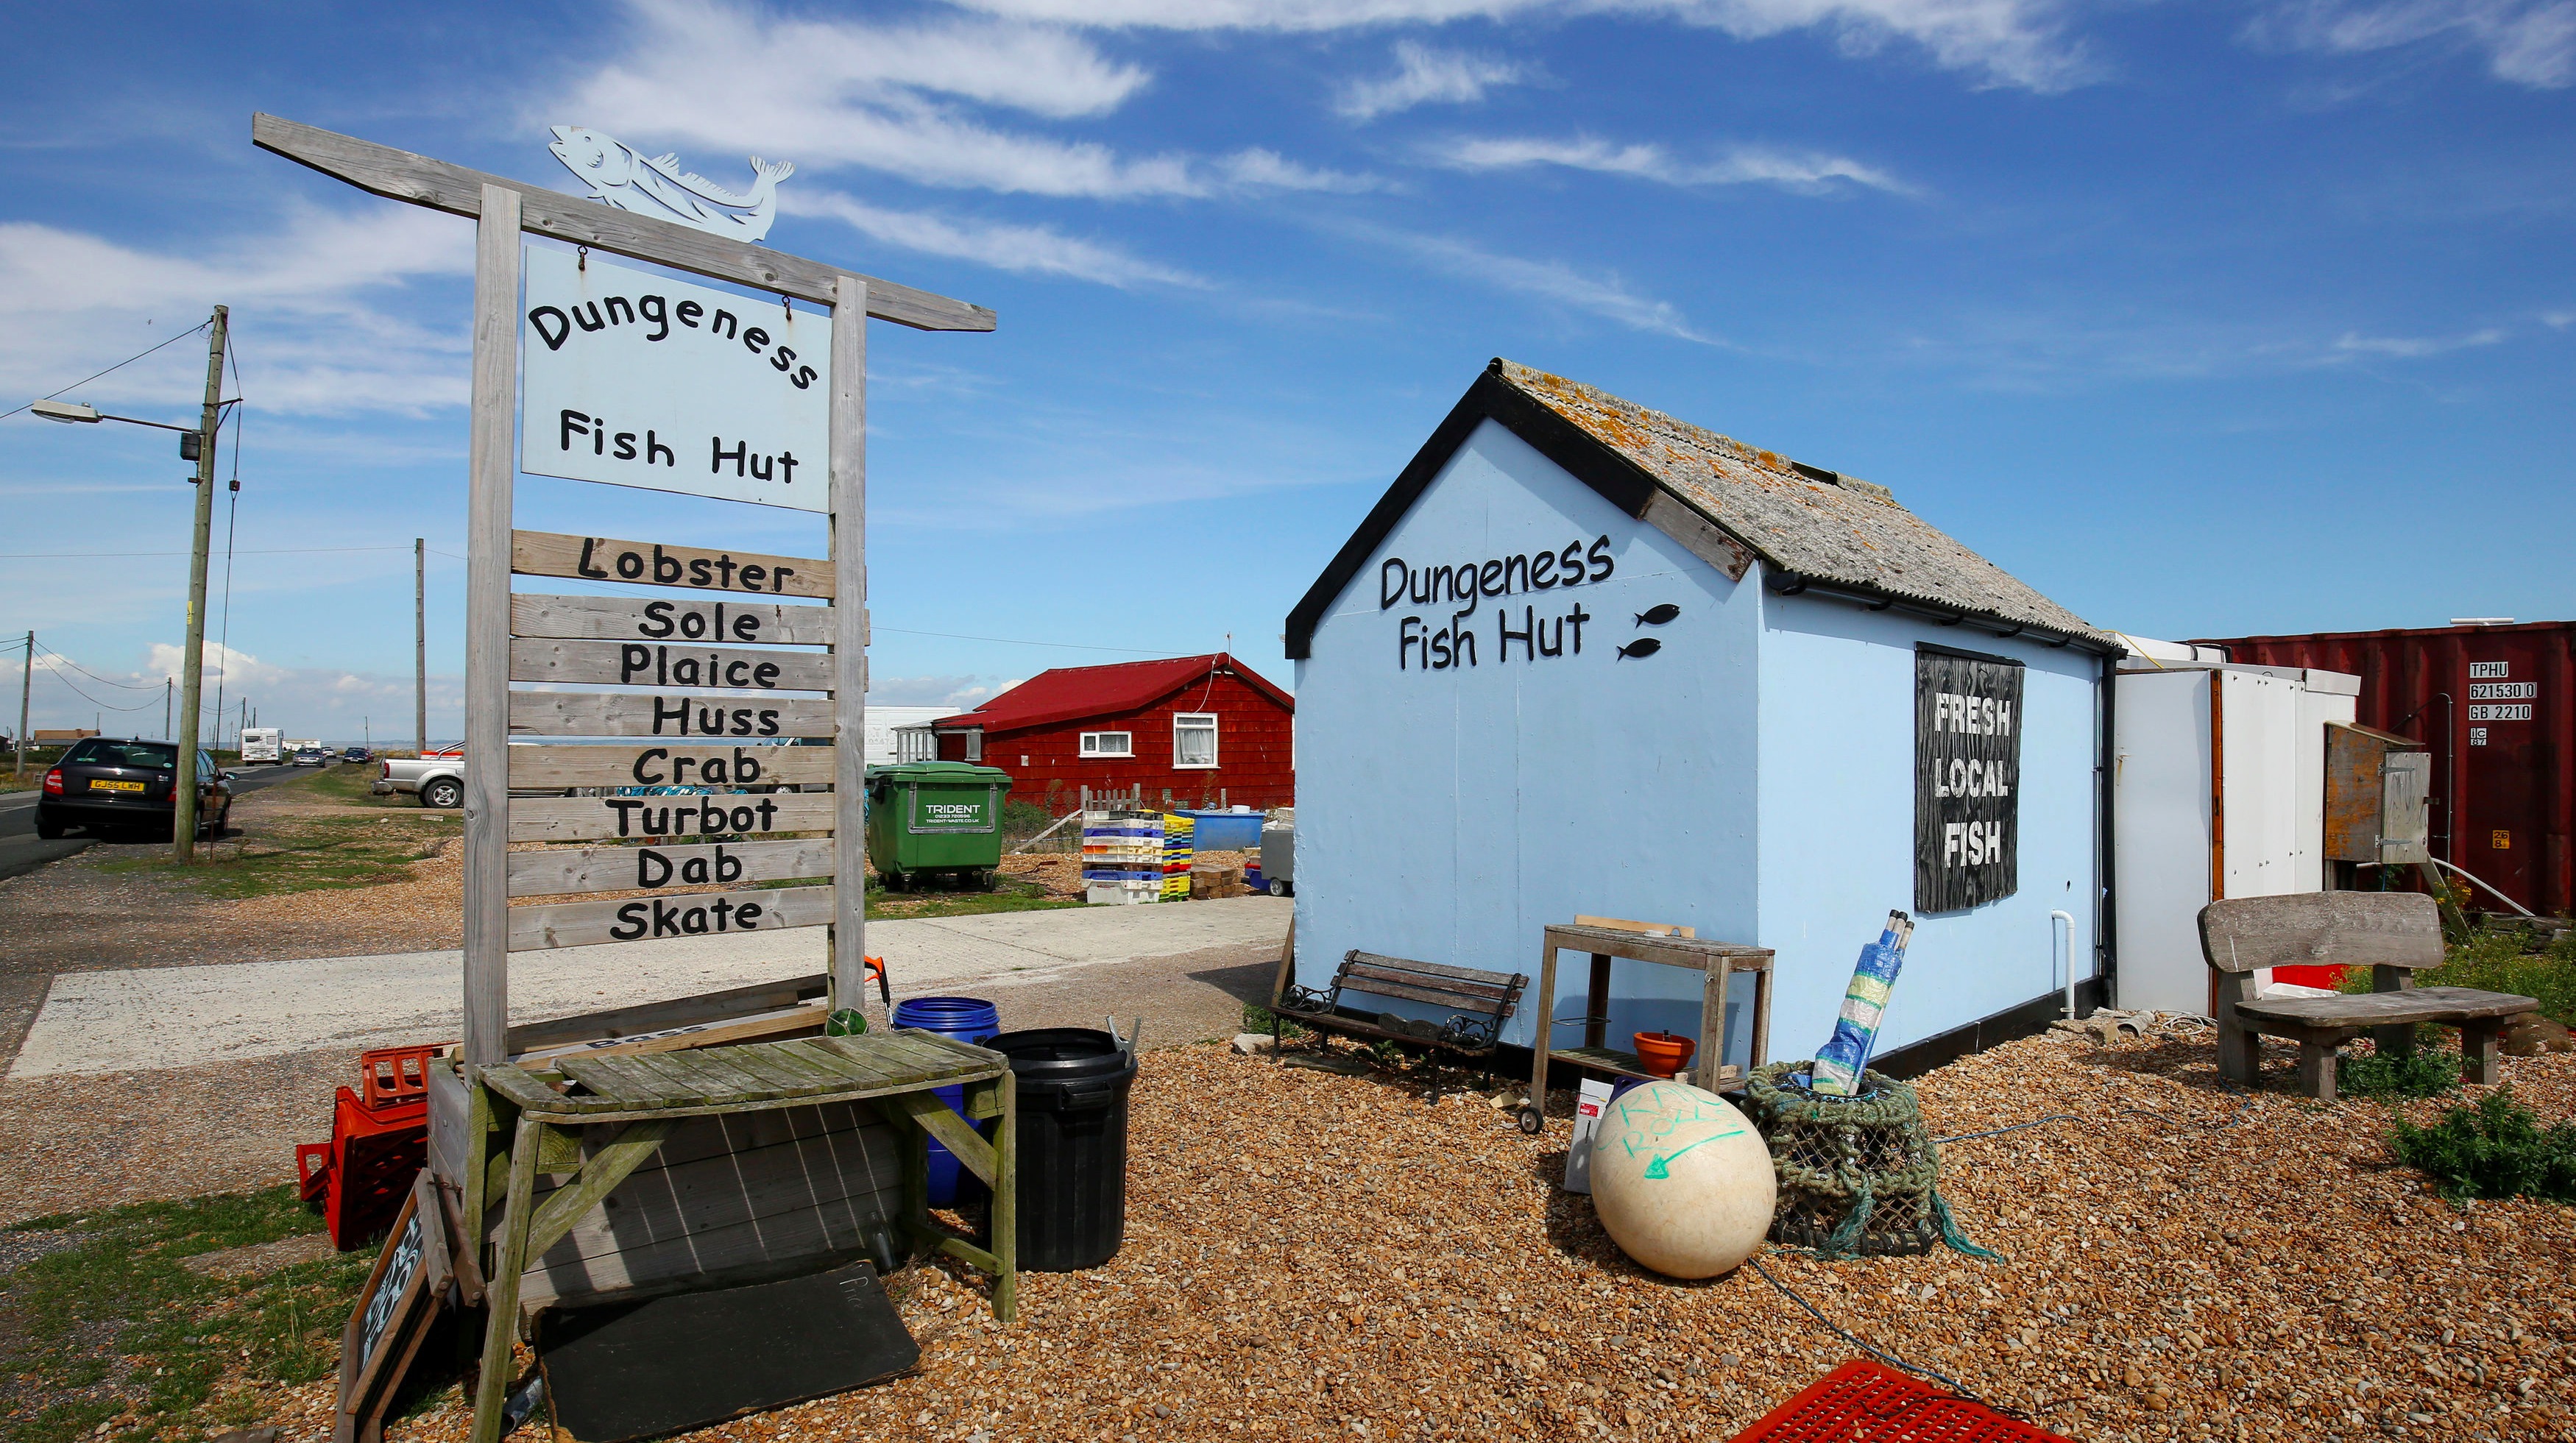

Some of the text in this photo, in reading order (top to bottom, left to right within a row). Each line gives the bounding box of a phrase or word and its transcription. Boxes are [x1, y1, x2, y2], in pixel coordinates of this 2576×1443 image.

[528, 294, 818, 391] Dungeness
[560, 409, 799, 484] Fish Hut
[577, 537, 795, 593] Lobster
[1380, 533, 1615, 617] Dungeness
[637, 600, 761, 642] Sole
[1400, 602, 1590, 670] Fish Hut
[620, 643, 782, 689] Plaice
[2471, 663, 2508, 677] TPHU
[2470, 684, 2522, 698] 621530
[2470, 705, 2530, 720] GB 2210
[652, 696, 780, 737] Huss
[1934, 692, 2011, 737] FRESH
[633, 747, 761, 785] Crab
[1934, 757, 2009, 798] LOCAL
[604, 795, 779, 837] Turbot
[925, 804, 981, 814] TRIDENT
[1944, 820, 2001, 869] FISH
[637, 844, 743, 889] Dab
[609, 896, 763, 940] Skate
[586, 1025, 709, 1049] Bass
